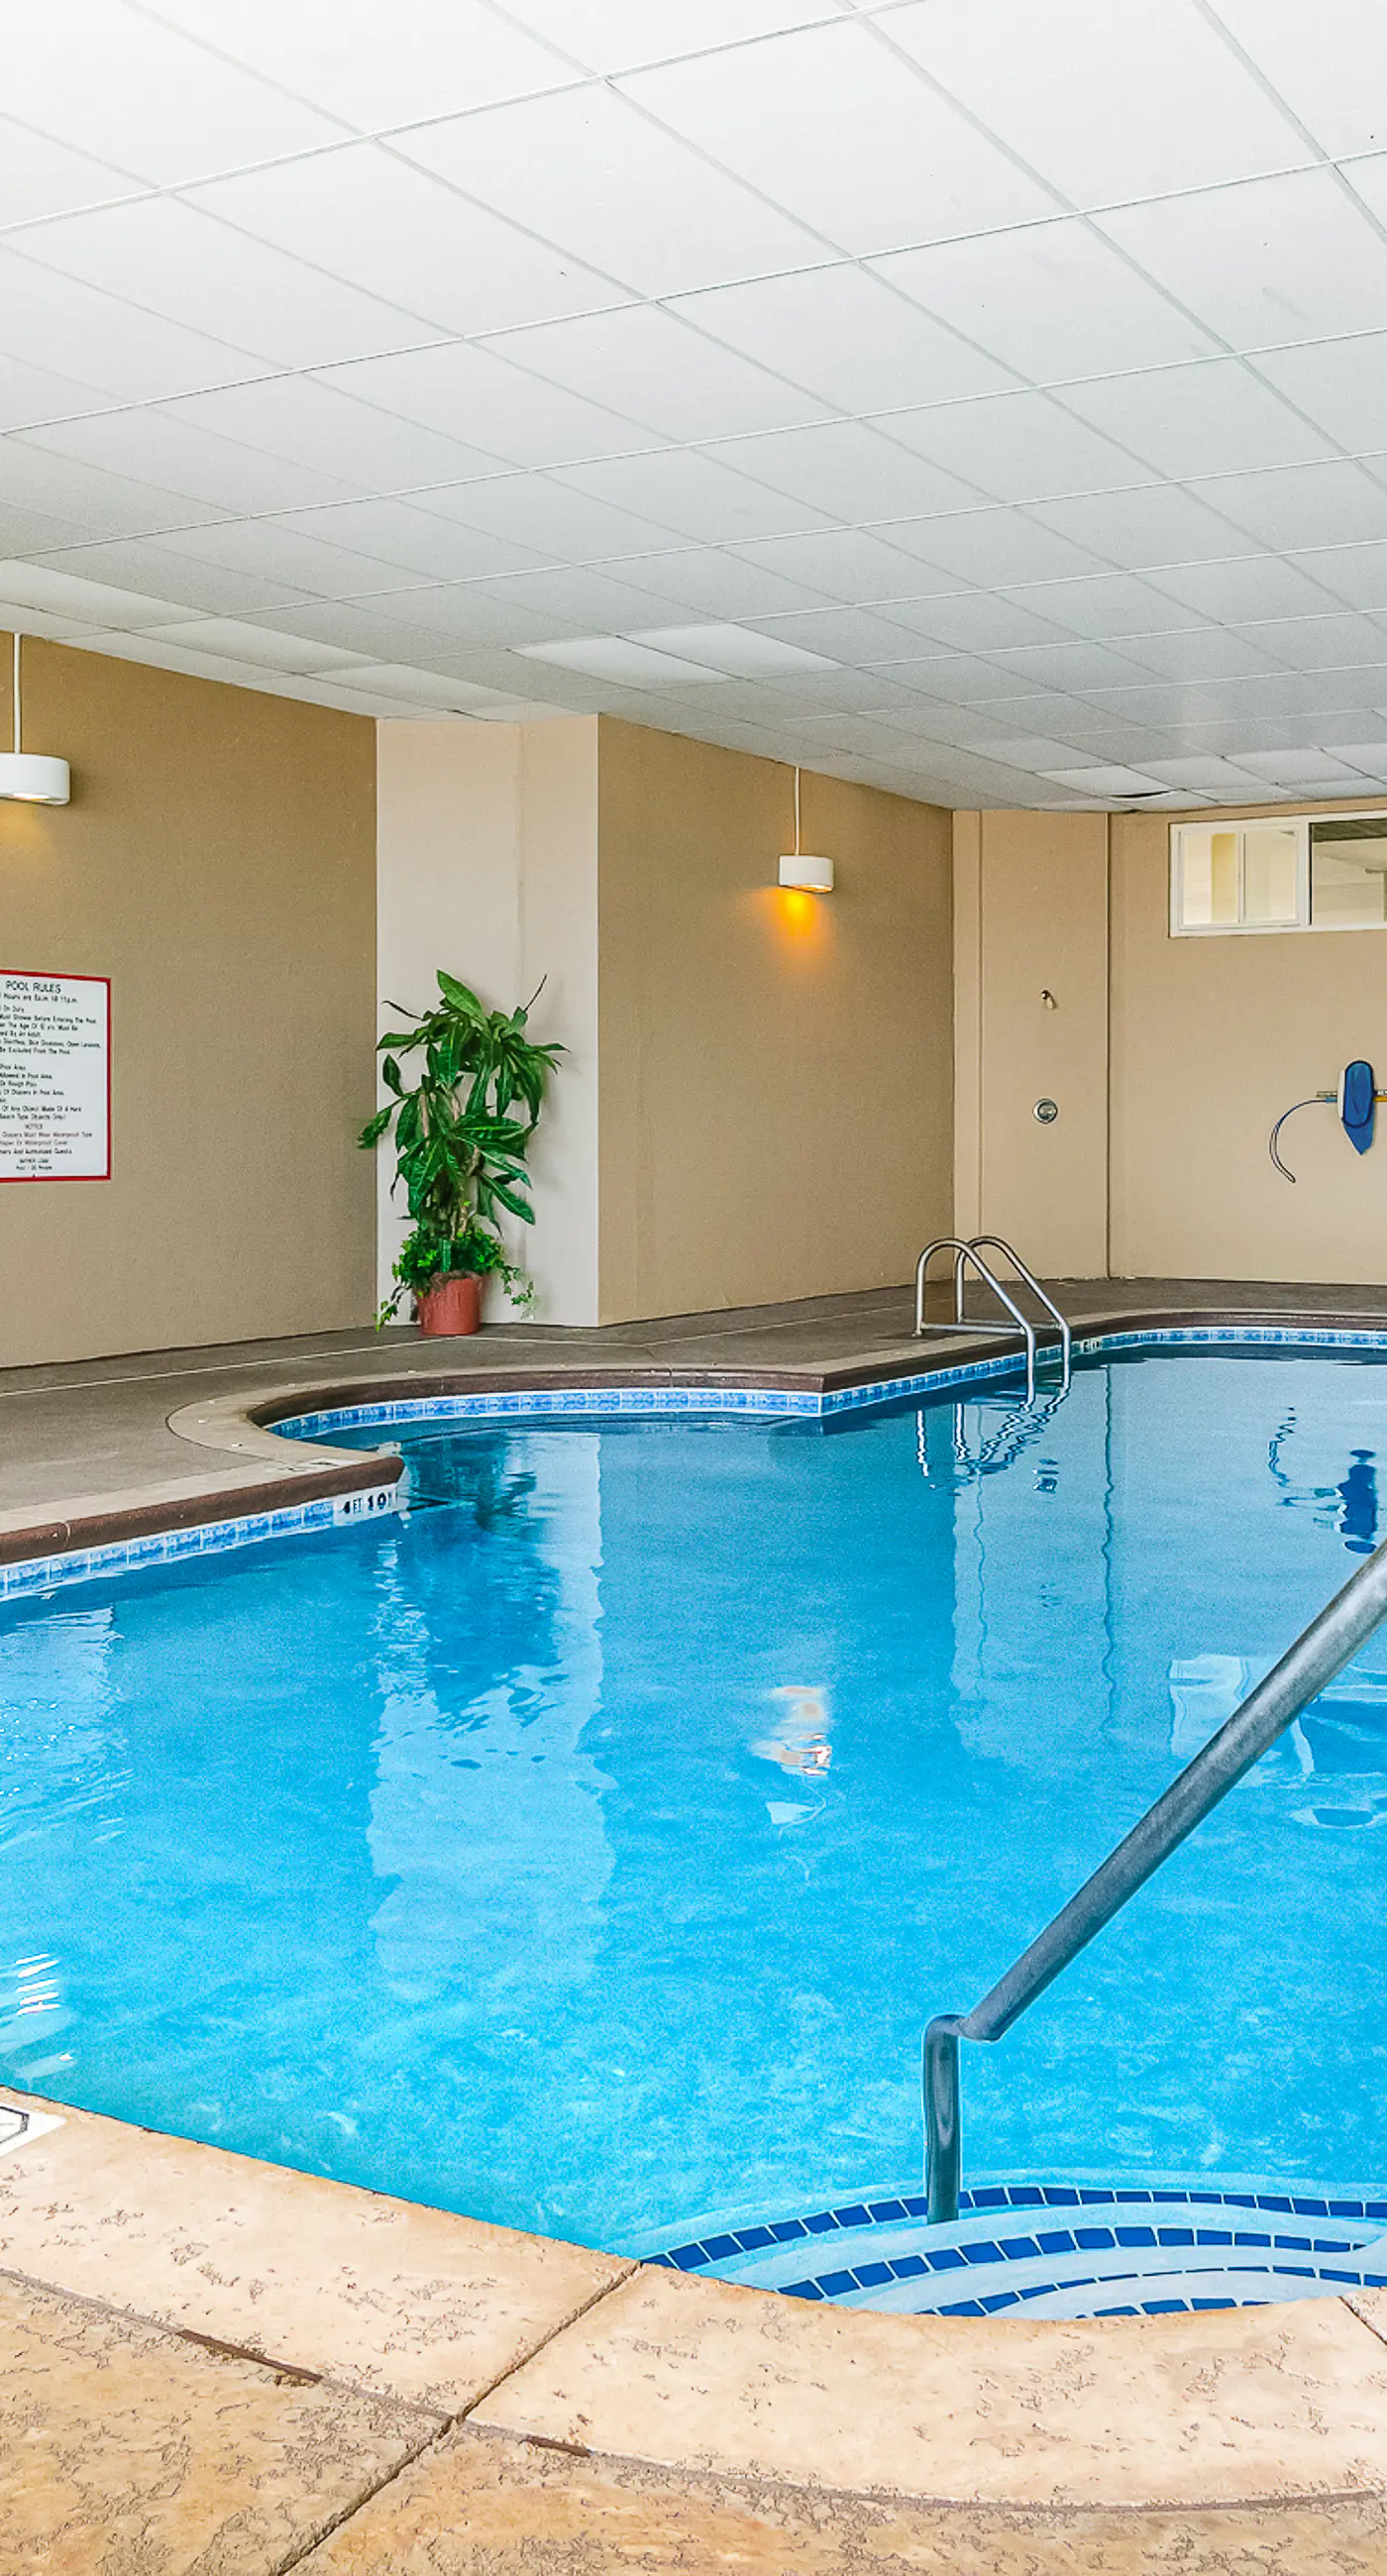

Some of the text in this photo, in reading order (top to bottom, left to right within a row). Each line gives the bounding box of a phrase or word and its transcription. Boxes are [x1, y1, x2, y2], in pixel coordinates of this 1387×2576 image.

[6, 980, 61, 994] POOL RULES
[341, 1501, 351, 1514] 4
[368, 1492, 386, 1511] 10
